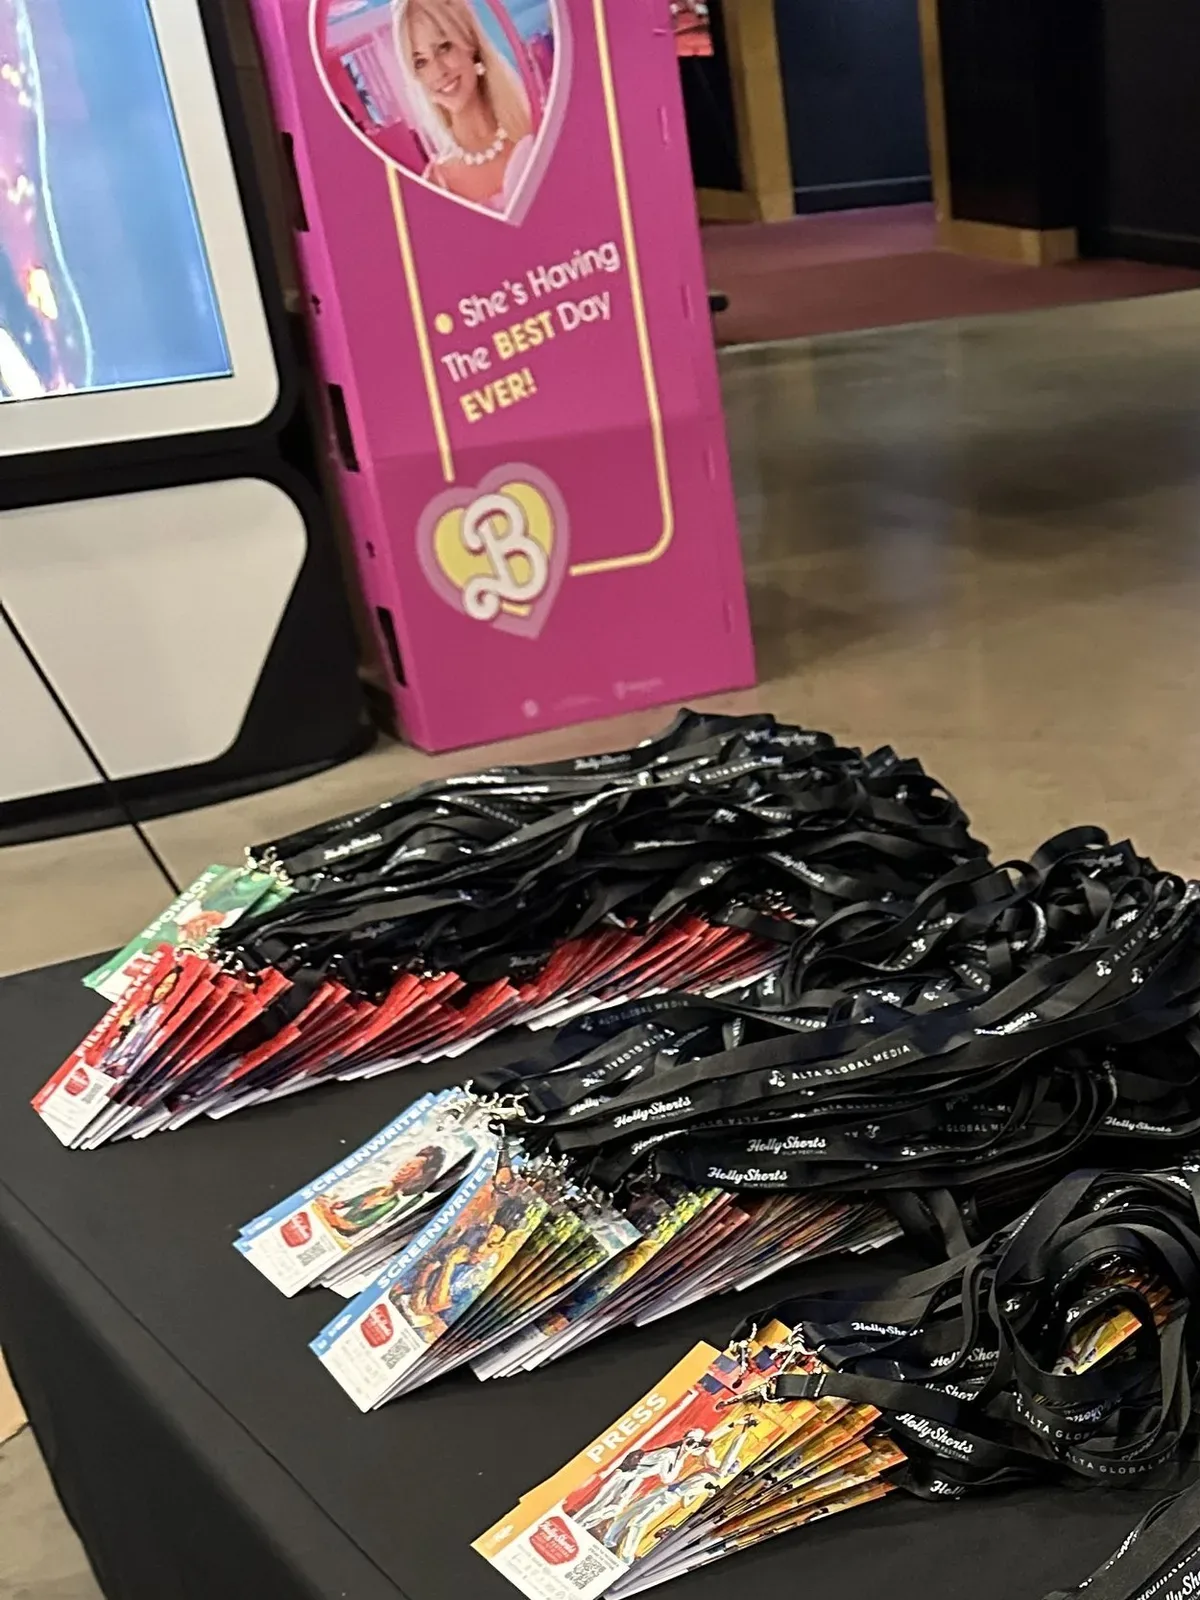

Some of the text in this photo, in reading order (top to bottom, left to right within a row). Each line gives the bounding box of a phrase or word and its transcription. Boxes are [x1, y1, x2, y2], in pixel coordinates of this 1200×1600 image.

[458, 242, 621, 329] She's Having
[441, 291, 611, 382] The BEST Day
[459, 368, 538, 423] EVER!
[462, 494, 548, 620] B
[75, 951, 164, 1057] FILMMAKER
[791, 1045, 912, 1081] ALTA GLOBAL MEDIA
[613, 1096, 692, 1128] HollyShorts
[300, 1100, 433, 1199] SCREENWRITER
[746, 1136, 828, 1155] HollyShorts
[706, 1166, 788, 1184] HollyShorts
[585, 1393, 668, 1463] PRESS
[895, 1413, 974, 1454] HollyShorts
[1024, 1409, 1050, 1435] ALTA
[1065, 1451, 1153, 1475] ALTA GLOBAL
